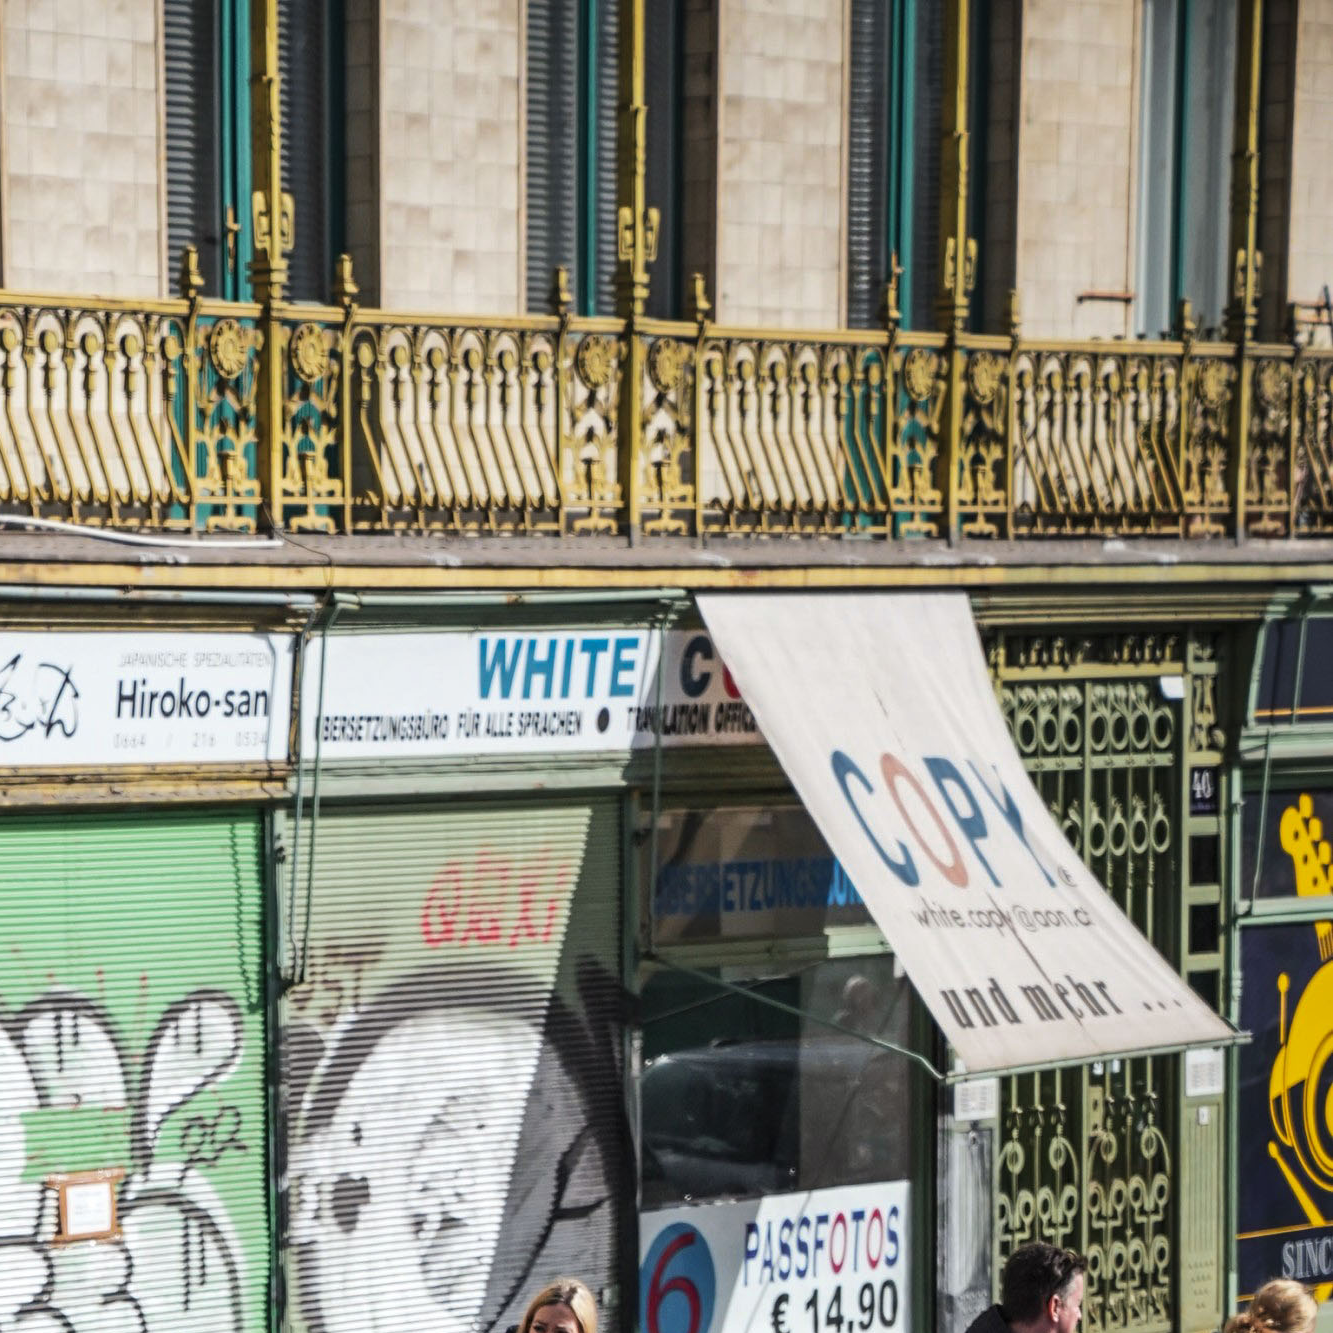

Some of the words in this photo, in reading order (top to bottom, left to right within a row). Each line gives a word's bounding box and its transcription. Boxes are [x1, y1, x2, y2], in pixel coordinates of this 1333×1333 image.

[478, 637, 640, 699] WHITE
[317, 708, 449, 743] BERSETZUNGSBÜRO
[456, 706, 480, 738] FÜR
[484, 711, 513, 738] ALLE
[517, 709, 583, 737] SPRACHEN
[626, 702, 710, 735] TRANLATION
[715, 702, 759, 734] OFFIC
[1192, 769, 1212, 799] 40
[830, 749, 1057, 889] COPY
[940, 977, 1022, 1029] und
[1018, 974, 1123, 1026] mehr
[743, 1205, 900, 1287] PASSFOTOS
